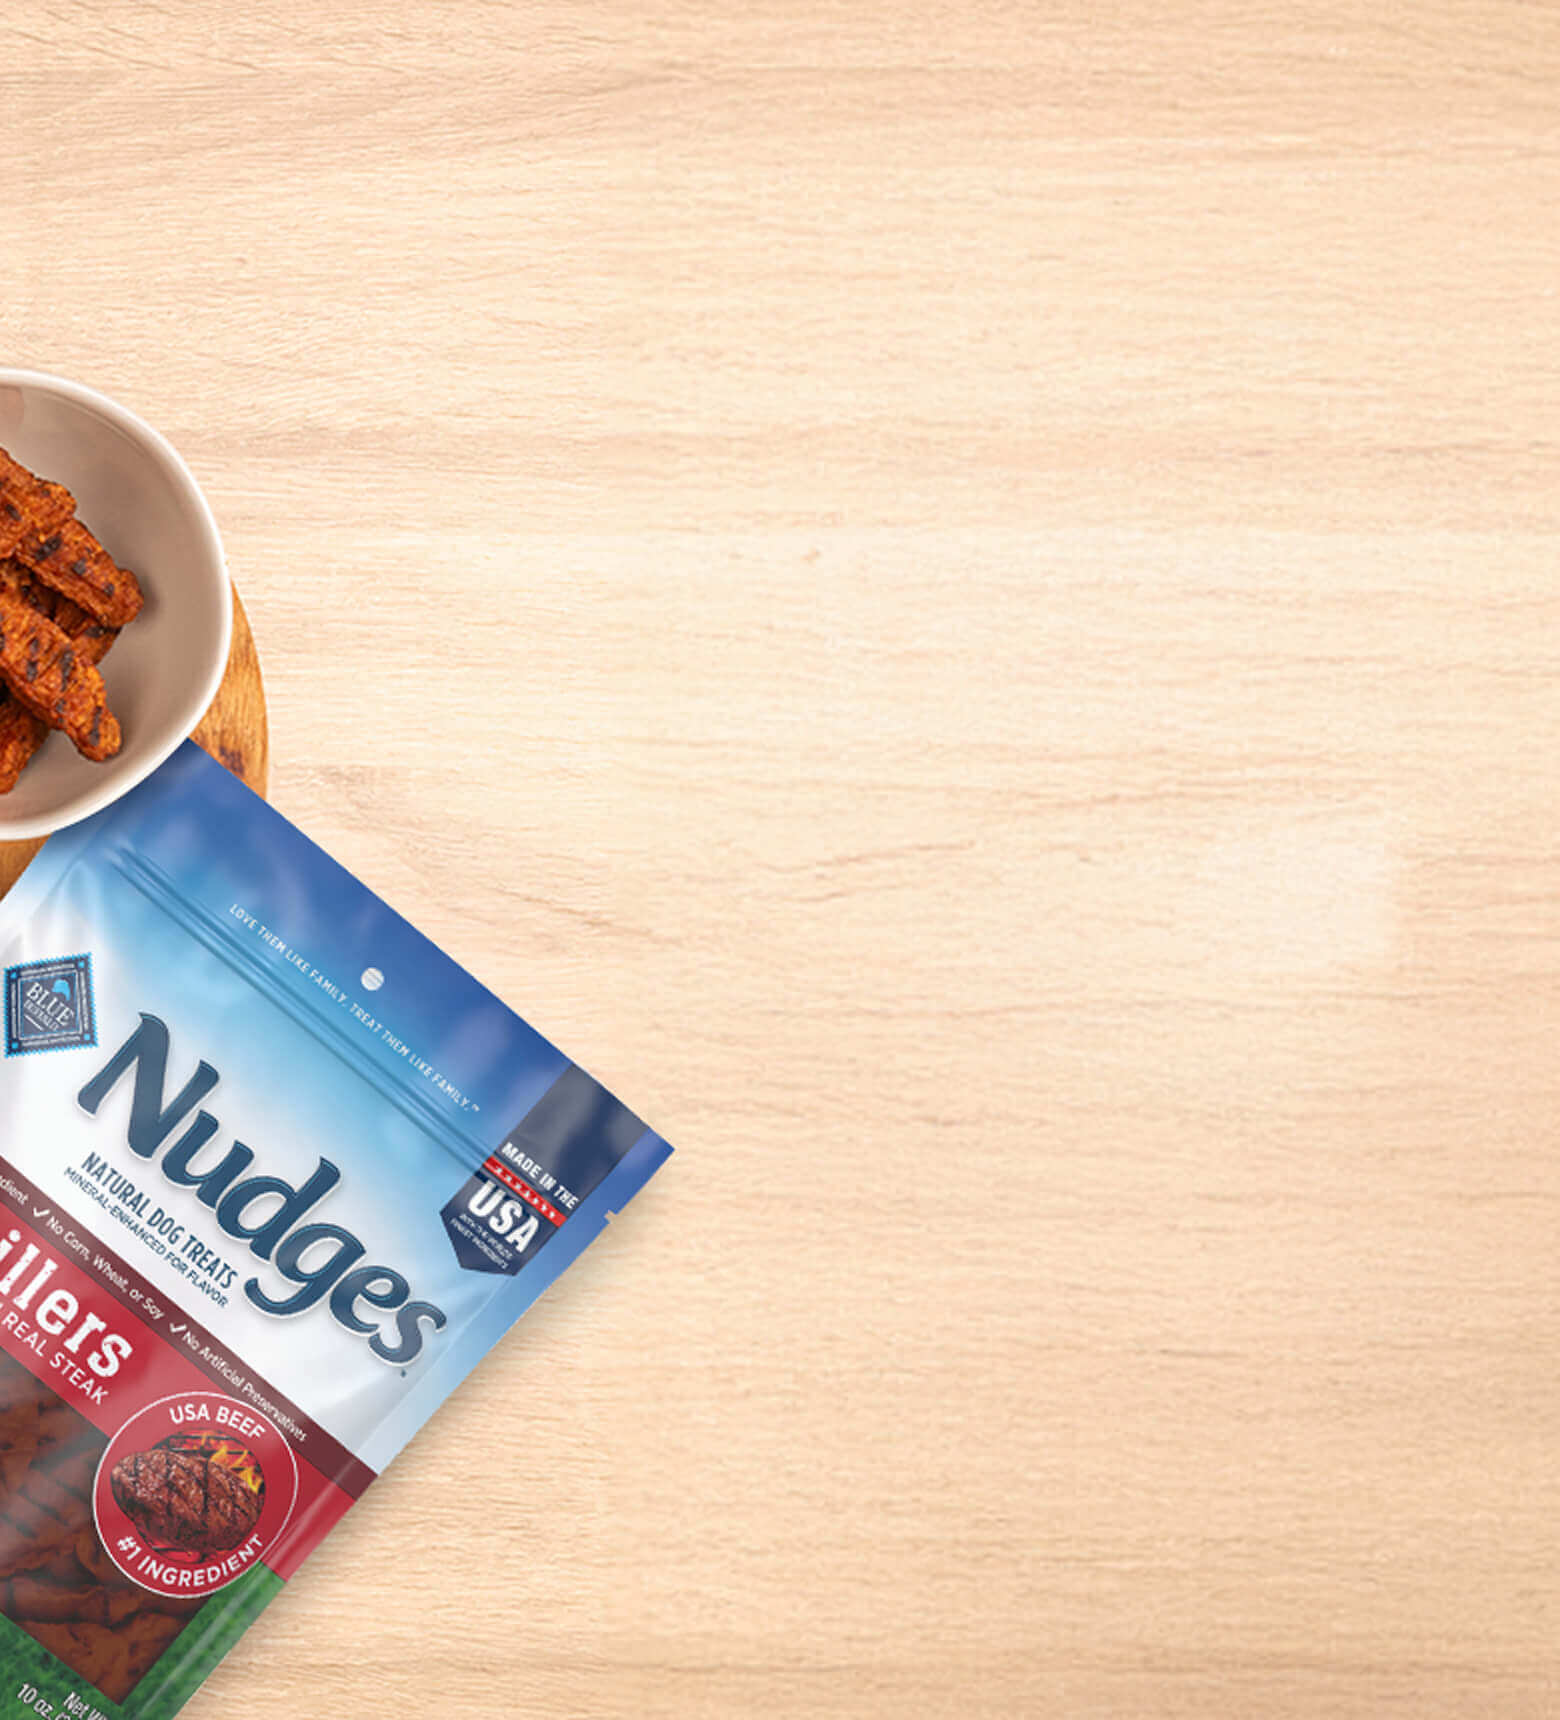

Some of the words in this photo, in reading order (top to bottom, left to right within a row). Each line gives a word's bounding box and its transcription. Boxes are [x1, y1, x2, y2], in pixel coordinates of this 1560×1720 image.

[26, 981, 75, 1026] BLUE
[229, 903, 258, 930] LOVE
[258, 925, 287, 953] THEM
[285, 949, 312, 973] LIKE
[310, 968, 349, 1007] FAMILY.
[349, 1003, 383, 1033] TREAT
[381, 1029, 411, 1057] THEM
[408, 1053, 433, 1078] LIKE
[78, 1012, 447, 1366] Nudges
[468, 1180, 540, 1253] USA
[501, 1142, 542, 1179] MADE
[539, 1173, 557, 1191] IN
[554, 1185, 579, 1209] THE
[64, 1167, 168, 1256] MINERAL-ENHANCED
[164, 1250, 191, 1278] FOR
[186, 1268, 229, 1309] FLAVOR
[81, 1152, 151, 1218] NATURAL
[147, 1208, 186, 1246] DOG
[179, 1235, 239, 1290] TREATS
[45, 1215, 64, 1235] No
[63, 1230, 90, 1261] Corn,
[92, 1253, 129, 1293] Wheat,
[129, 1288, 144, 1304] or
[142, 1299, 165, 1321] Soy
[1, 1311, 48, 1357] REAL
[49, 1351, 109, 1405] STEAK
[182, 1331, 200, 1350] No
[199, 1346, 246, 1387] Artificial
[241, 1381, 308, 1443] Preservatives
[169, 1403, 211, 1424] USA
[215, 1405, 266, 1439] BEEF
[117, 1535, 142, 1561] #1
[137, 1533, 264, 1587] INGREDIENT
[17, 1683, 38, 1704] 10
[63, 1691, 90, 1719] Net
